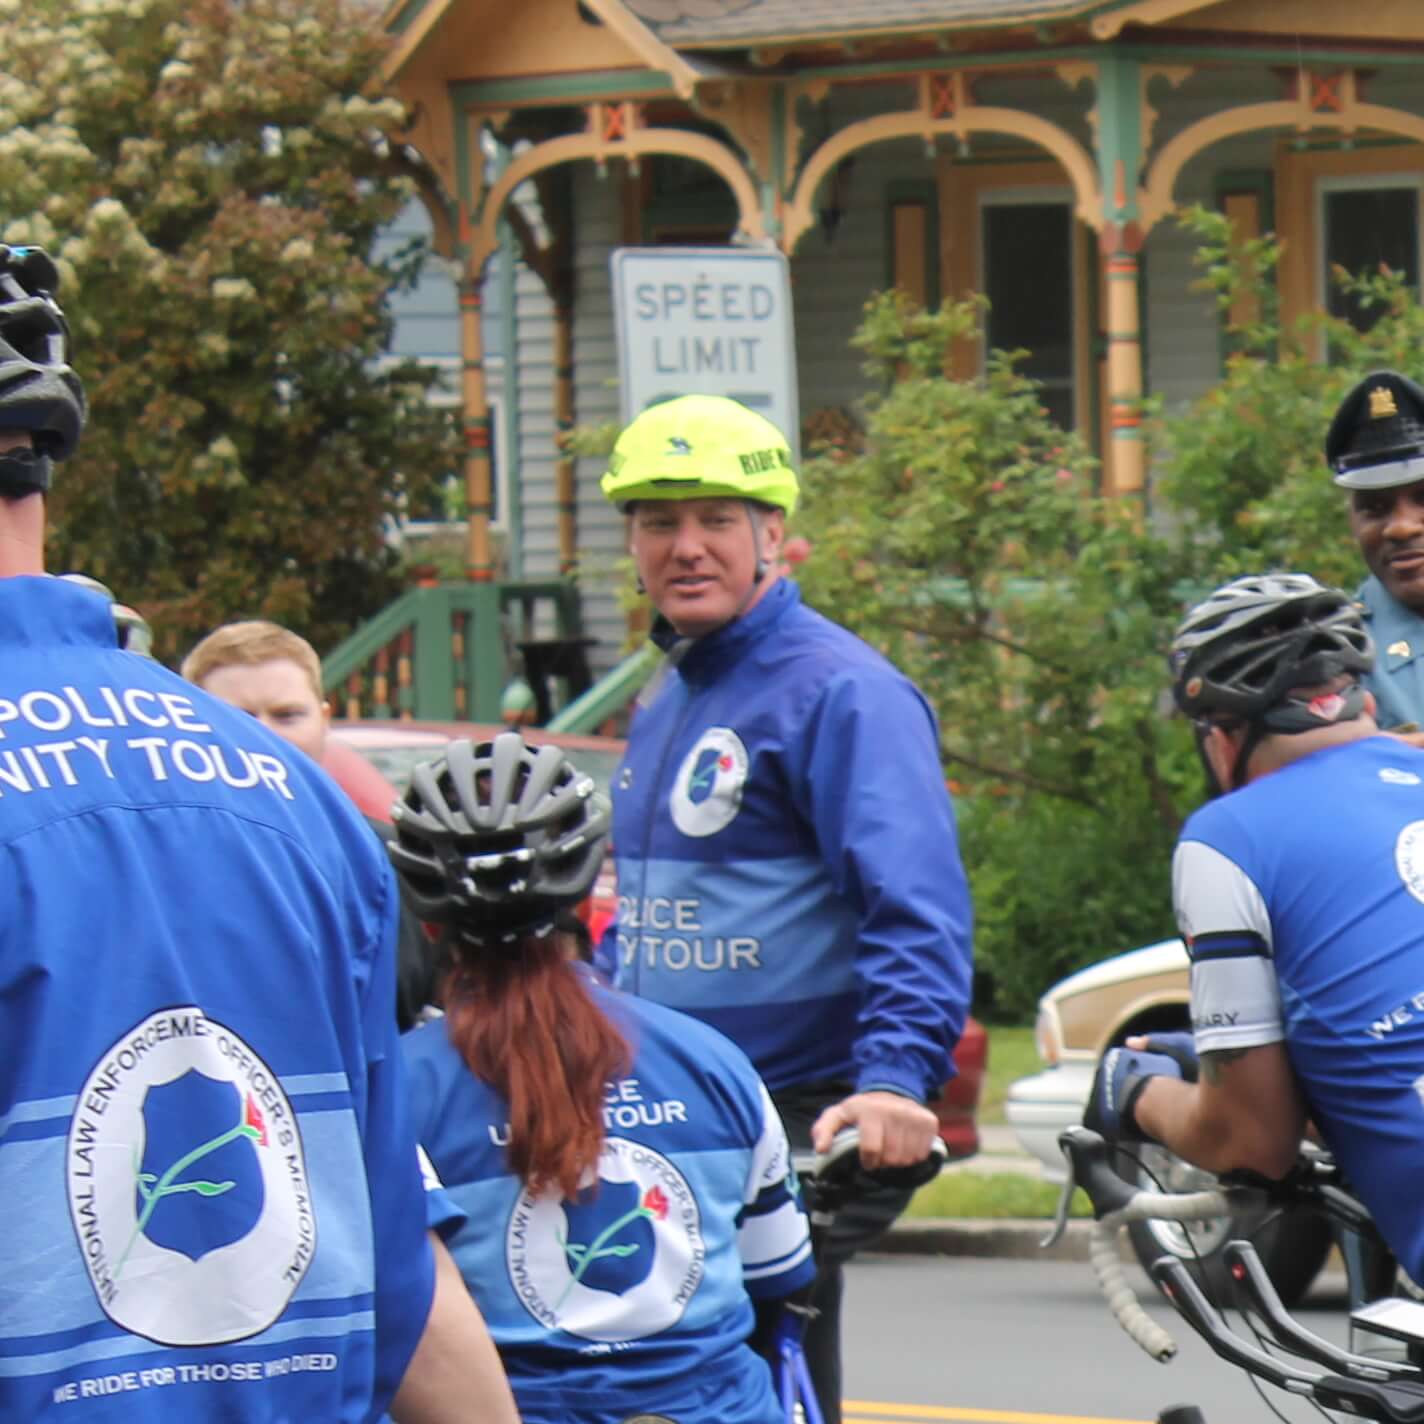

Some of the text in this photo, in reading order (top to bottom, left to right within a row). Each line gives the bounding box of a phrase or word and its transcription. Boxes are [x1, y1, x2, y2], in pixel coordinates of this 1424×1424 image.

[635, 283, 775, 321] SPEED
[652, 335, 762, 375] LIMIT
[0, 686, 211, 738] POLICE
[0, 735, 296, 800] NITY TOUR
[618, 896, 703, 932] OLICE
[639, 936, 762, 971] TOUR
[1365, 1004, 1414, 1040] WE
[85, 1015, 209, 1115] ENFORCEME
[74, 1123, 98, 1179] LAW
[510, 1211, 531, 1247] LAW
[80, 1372, 140, 1400] RIDE
[140, 1367, 177, 1389] FOR
[179, 1362, 263, 1384] THOSE
